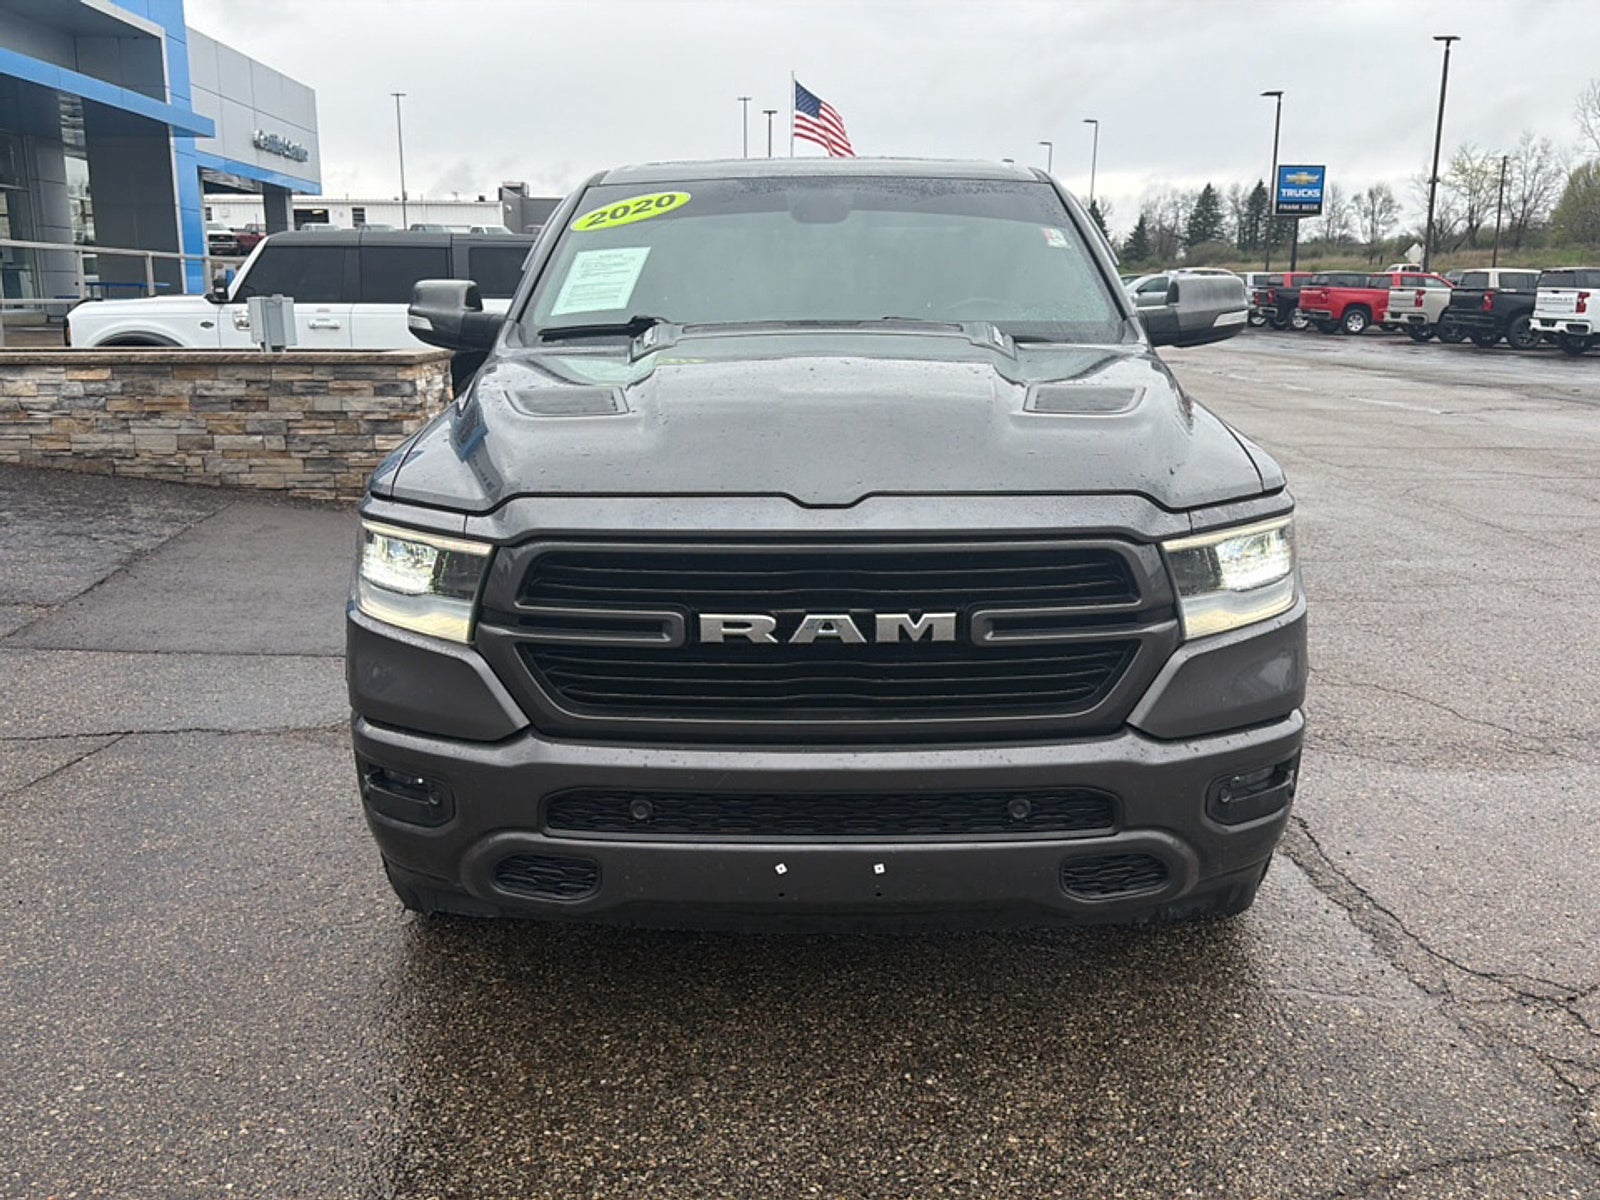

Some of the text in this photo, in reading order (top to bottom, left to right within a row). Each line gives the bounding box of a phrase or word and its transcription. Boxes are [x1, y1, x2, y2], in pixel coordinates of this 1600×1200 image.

[1280, 188, 1321, 198] TRUCKS
[585, 194, 677, 228] 2020
[699, 612, 957, 643] RAM
